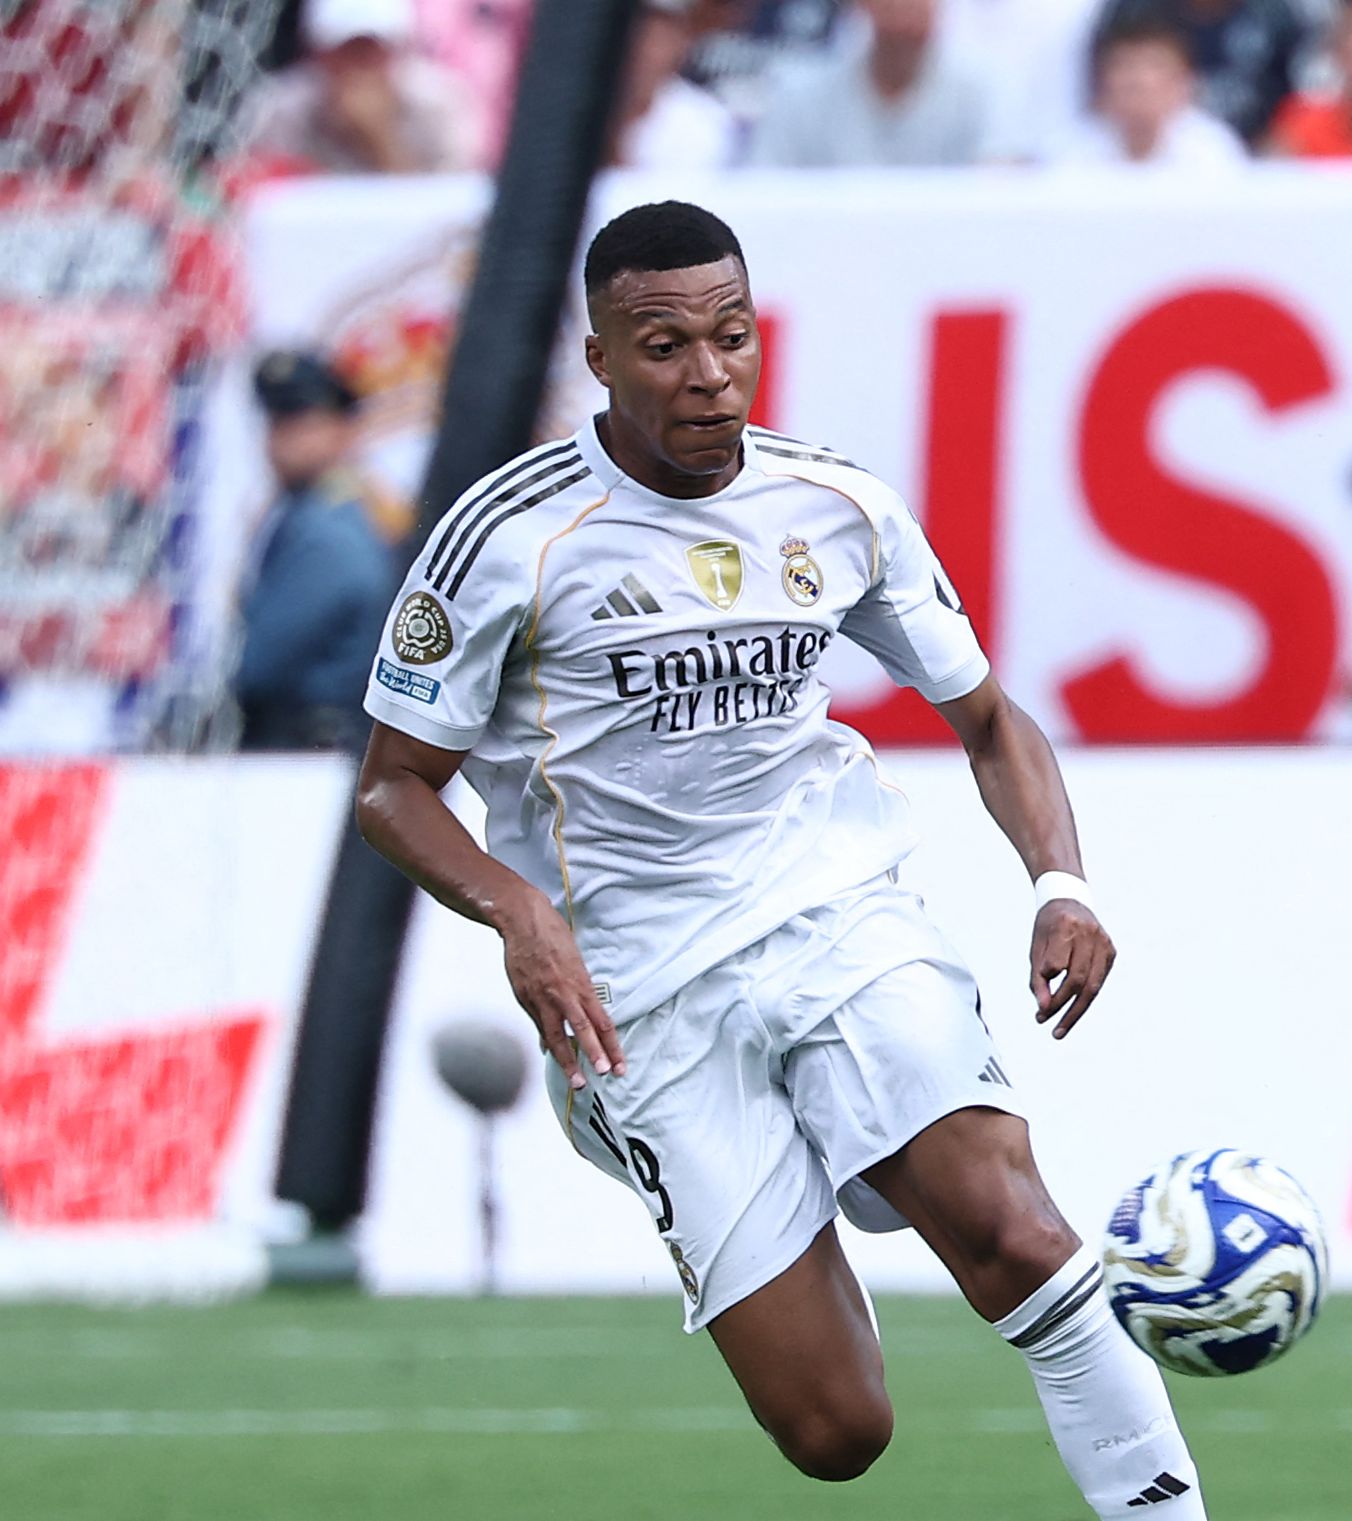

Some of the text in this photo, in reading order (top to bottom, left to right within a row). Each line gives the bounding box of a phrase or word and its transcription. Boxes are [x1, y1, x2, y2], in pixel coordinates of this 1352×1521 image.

[430, 607, 445, 627] CUP
[397, 642, 425, 661] FIFA
[651, 691, 702, 732] FLY
